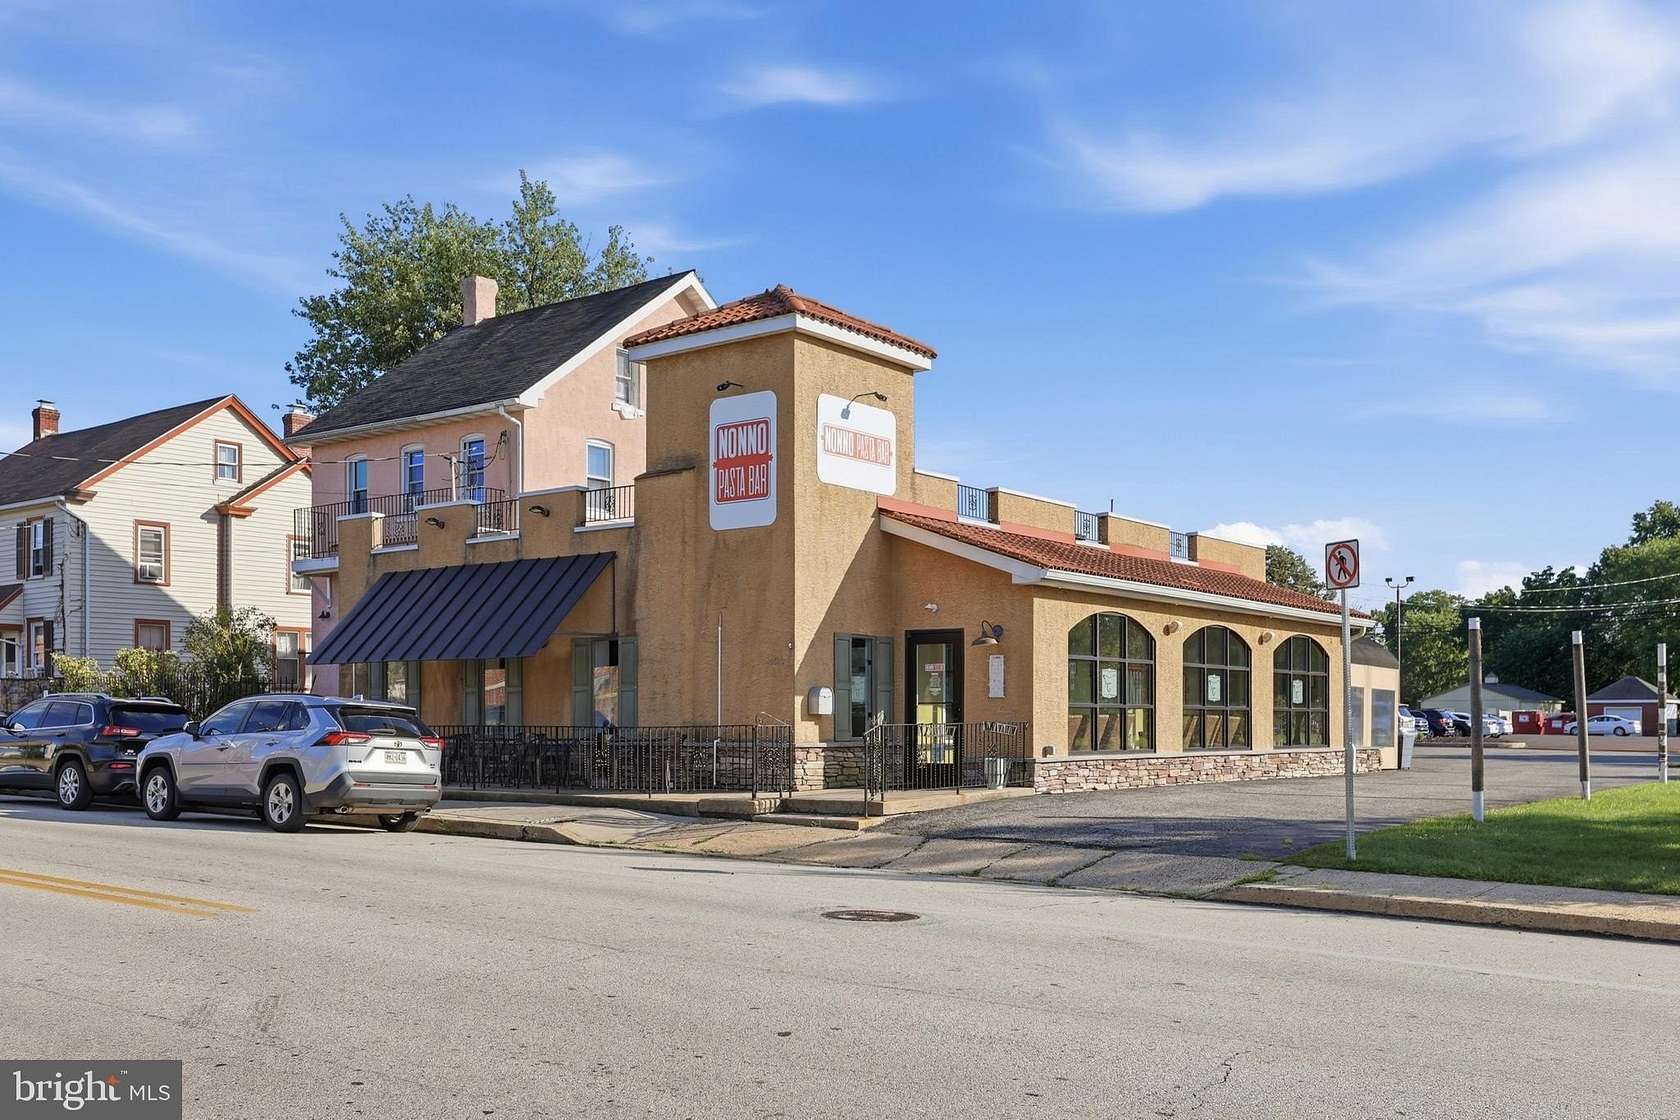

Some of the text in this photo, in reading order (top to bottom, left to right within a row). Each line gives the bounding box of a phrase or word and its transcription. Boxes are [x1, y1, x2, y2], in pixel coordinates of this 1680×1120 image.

[719, 423, 767, 459] NONNO
[825, 425, 854, 457] NONNO
[718, 463, 767, 499] PASTA BAR
